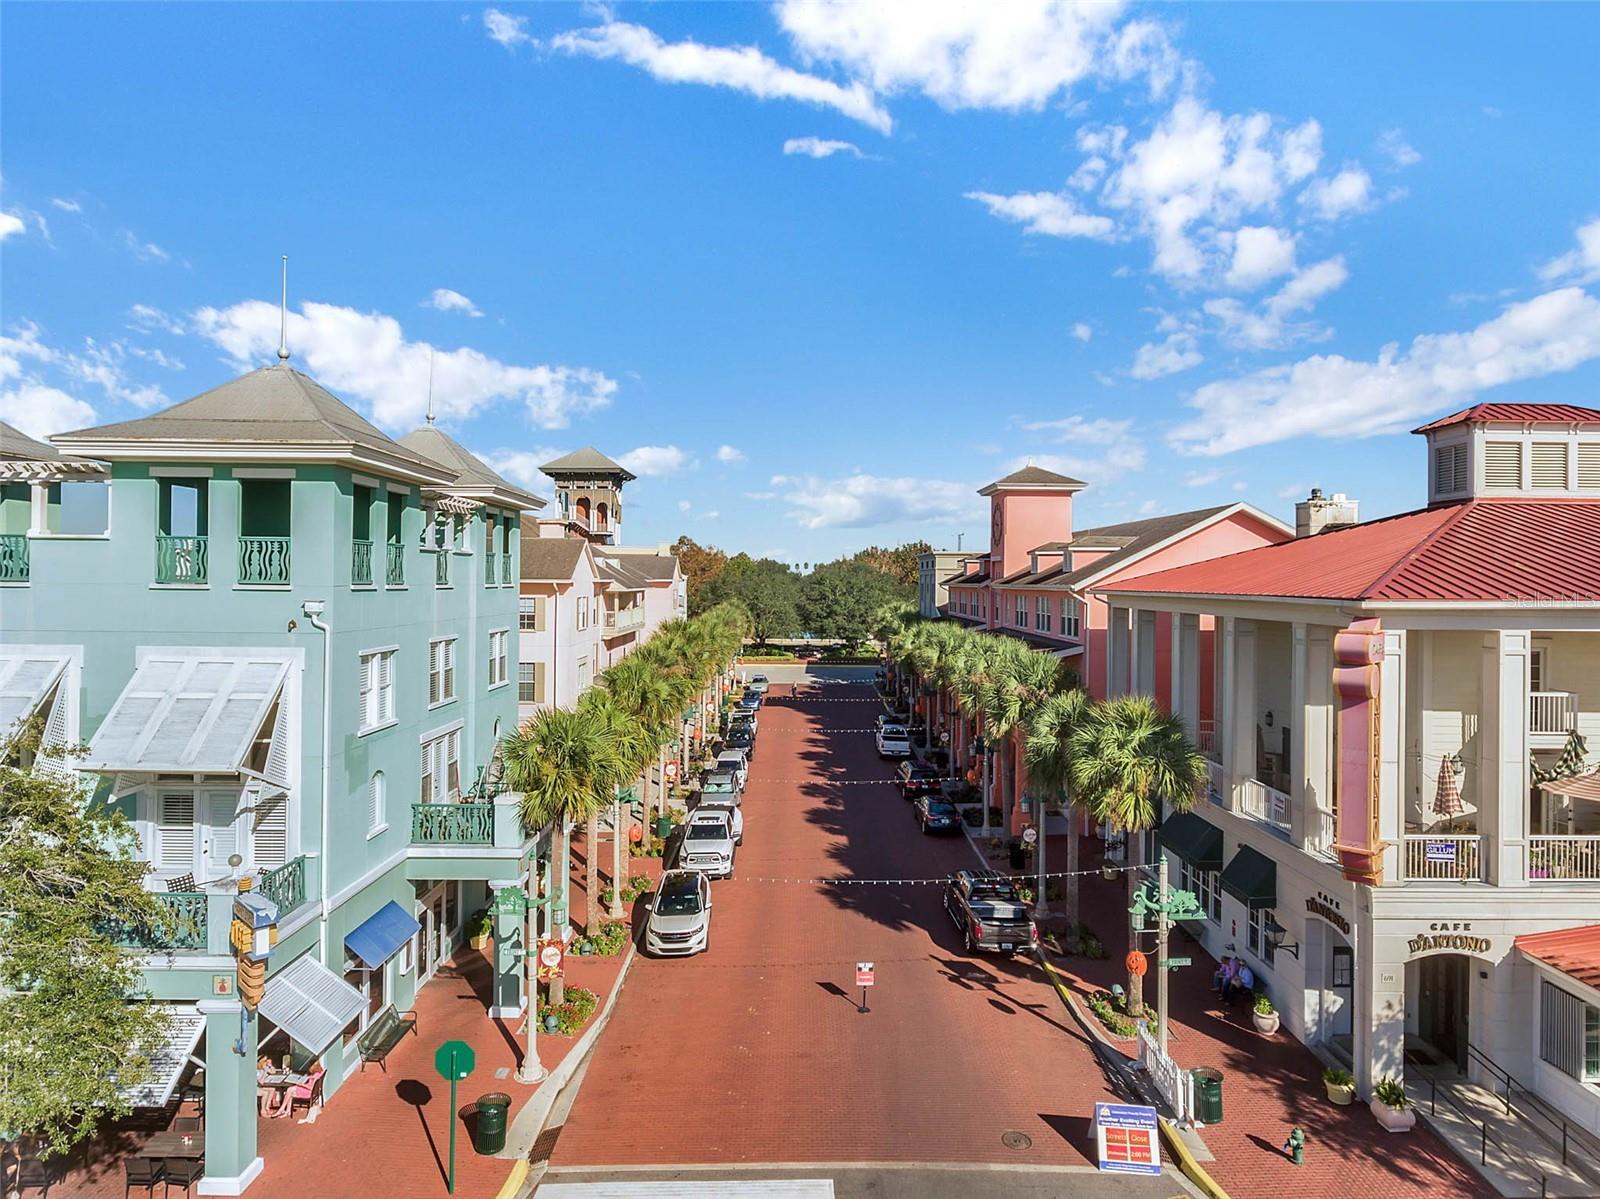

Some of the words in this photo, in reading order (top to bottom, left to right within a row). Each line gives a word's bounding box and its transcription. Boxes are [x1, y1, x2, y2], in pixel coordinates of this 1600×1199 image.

[1317, 891, 1340, 910] CAFE
[1430, 923, 1472, 931] CAFE
[1407, 933, 1492, 954] D'ANTONIO
